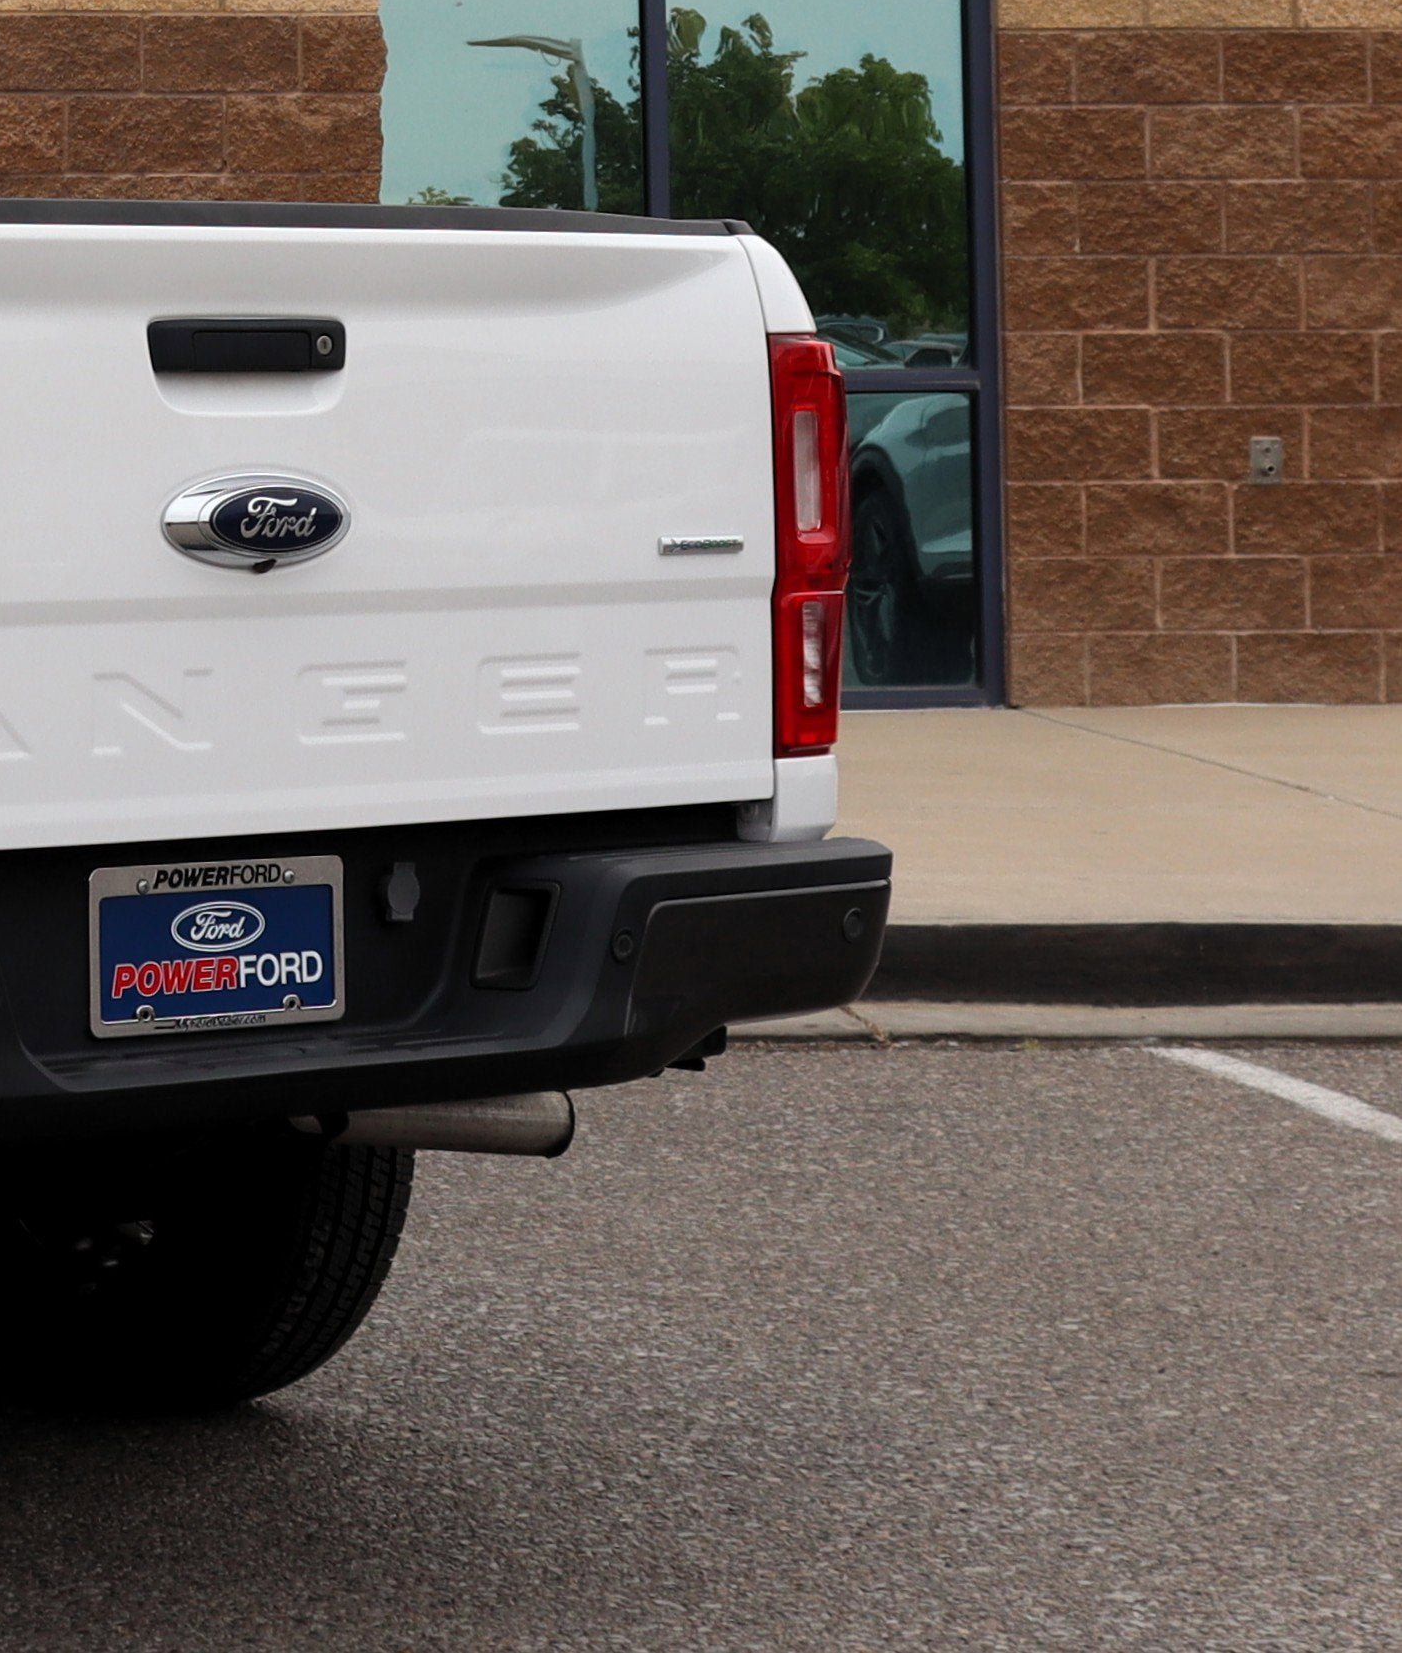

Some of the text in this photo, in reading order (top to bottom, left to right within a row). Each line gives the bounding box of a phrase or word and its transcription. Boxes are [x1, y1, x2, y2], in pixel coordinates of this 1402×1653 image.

[240, 496, 317, 538] Ford
[152, 863, 282, 890] POWERFORD
[190, 910, 246, 942] Ford
[111, 950, 324, 999] POWERFORD
